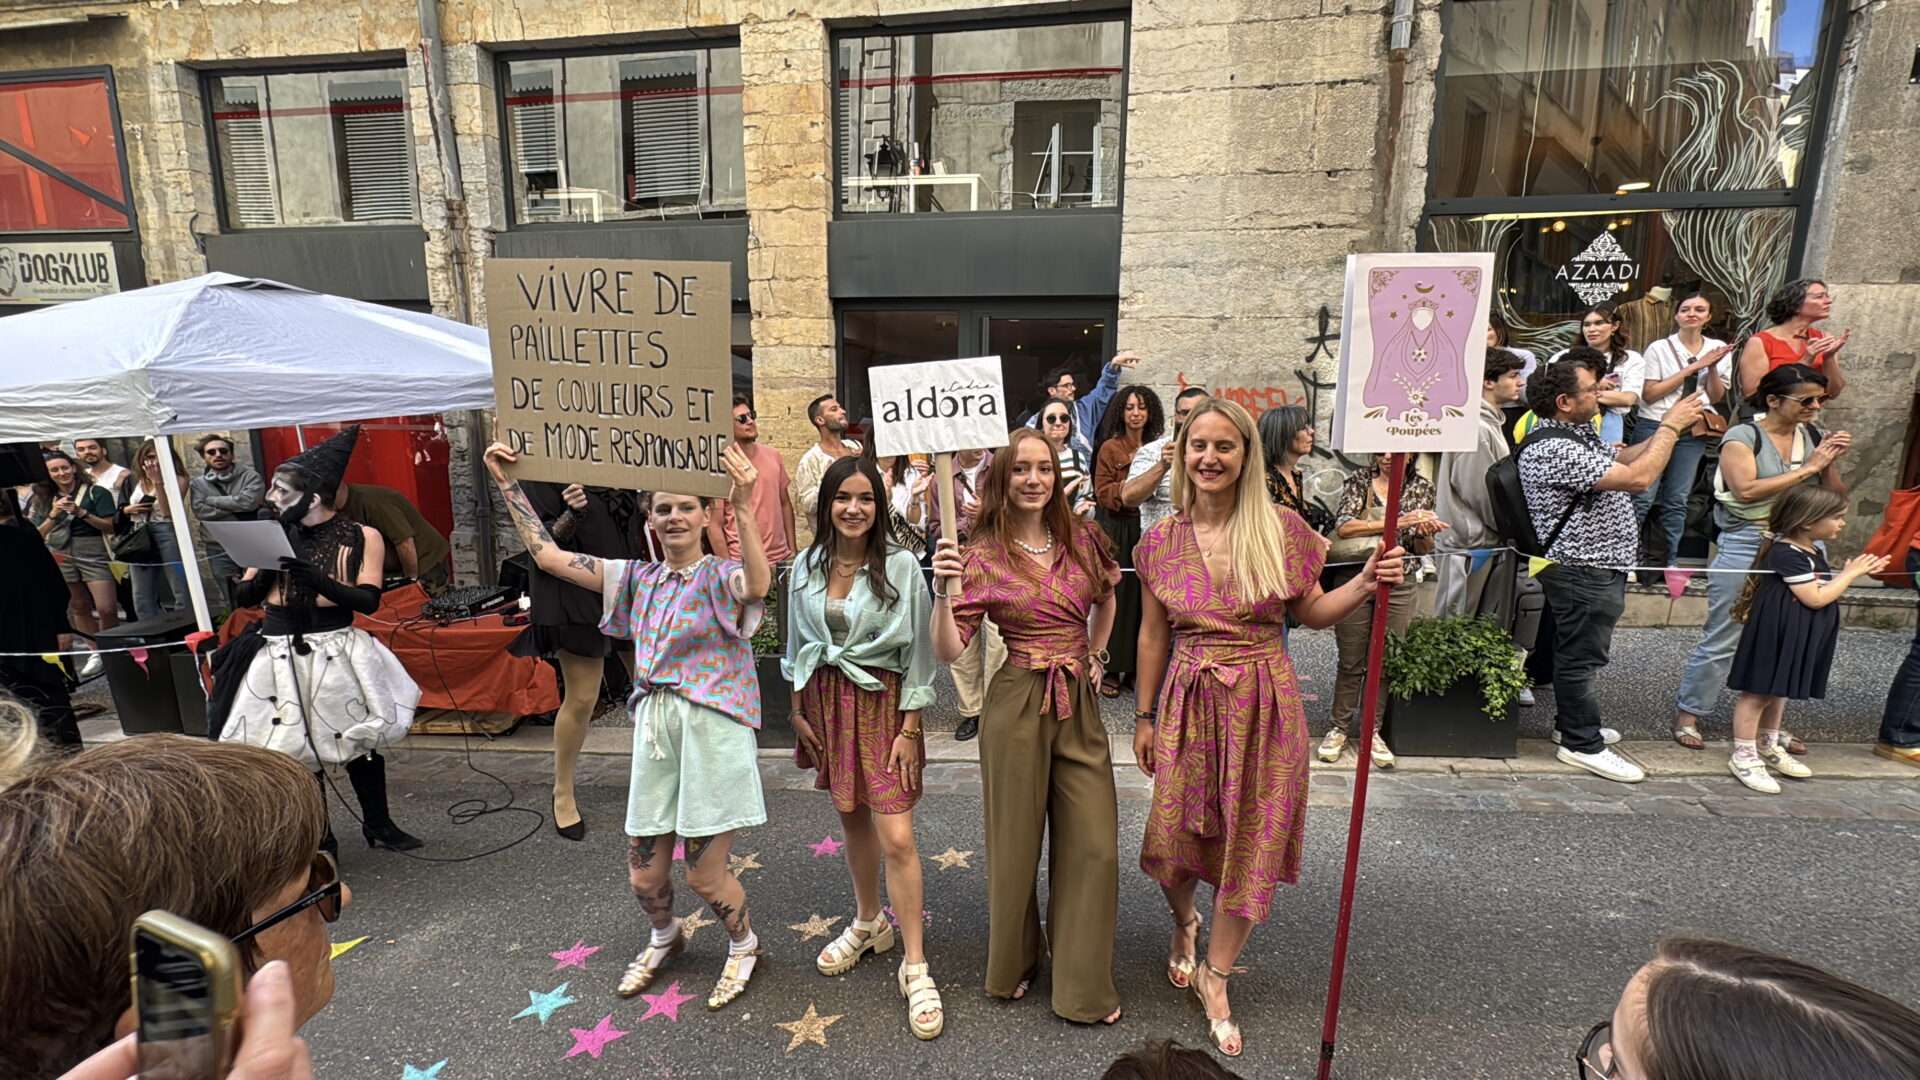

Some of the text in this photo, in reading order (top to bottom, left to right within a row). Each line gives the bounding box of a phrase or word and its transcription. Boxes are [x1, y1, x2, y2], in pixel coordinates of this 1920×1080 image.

[653, 271, 699, 316] DE
[1554, 263, 1640, 280] AZAADI
[511, 376, 715, 423] DE COULEURS ET
[881, 386, 998, 423] aldora
[507, 422, 728, 475] DE MODE RESPONSABLE
